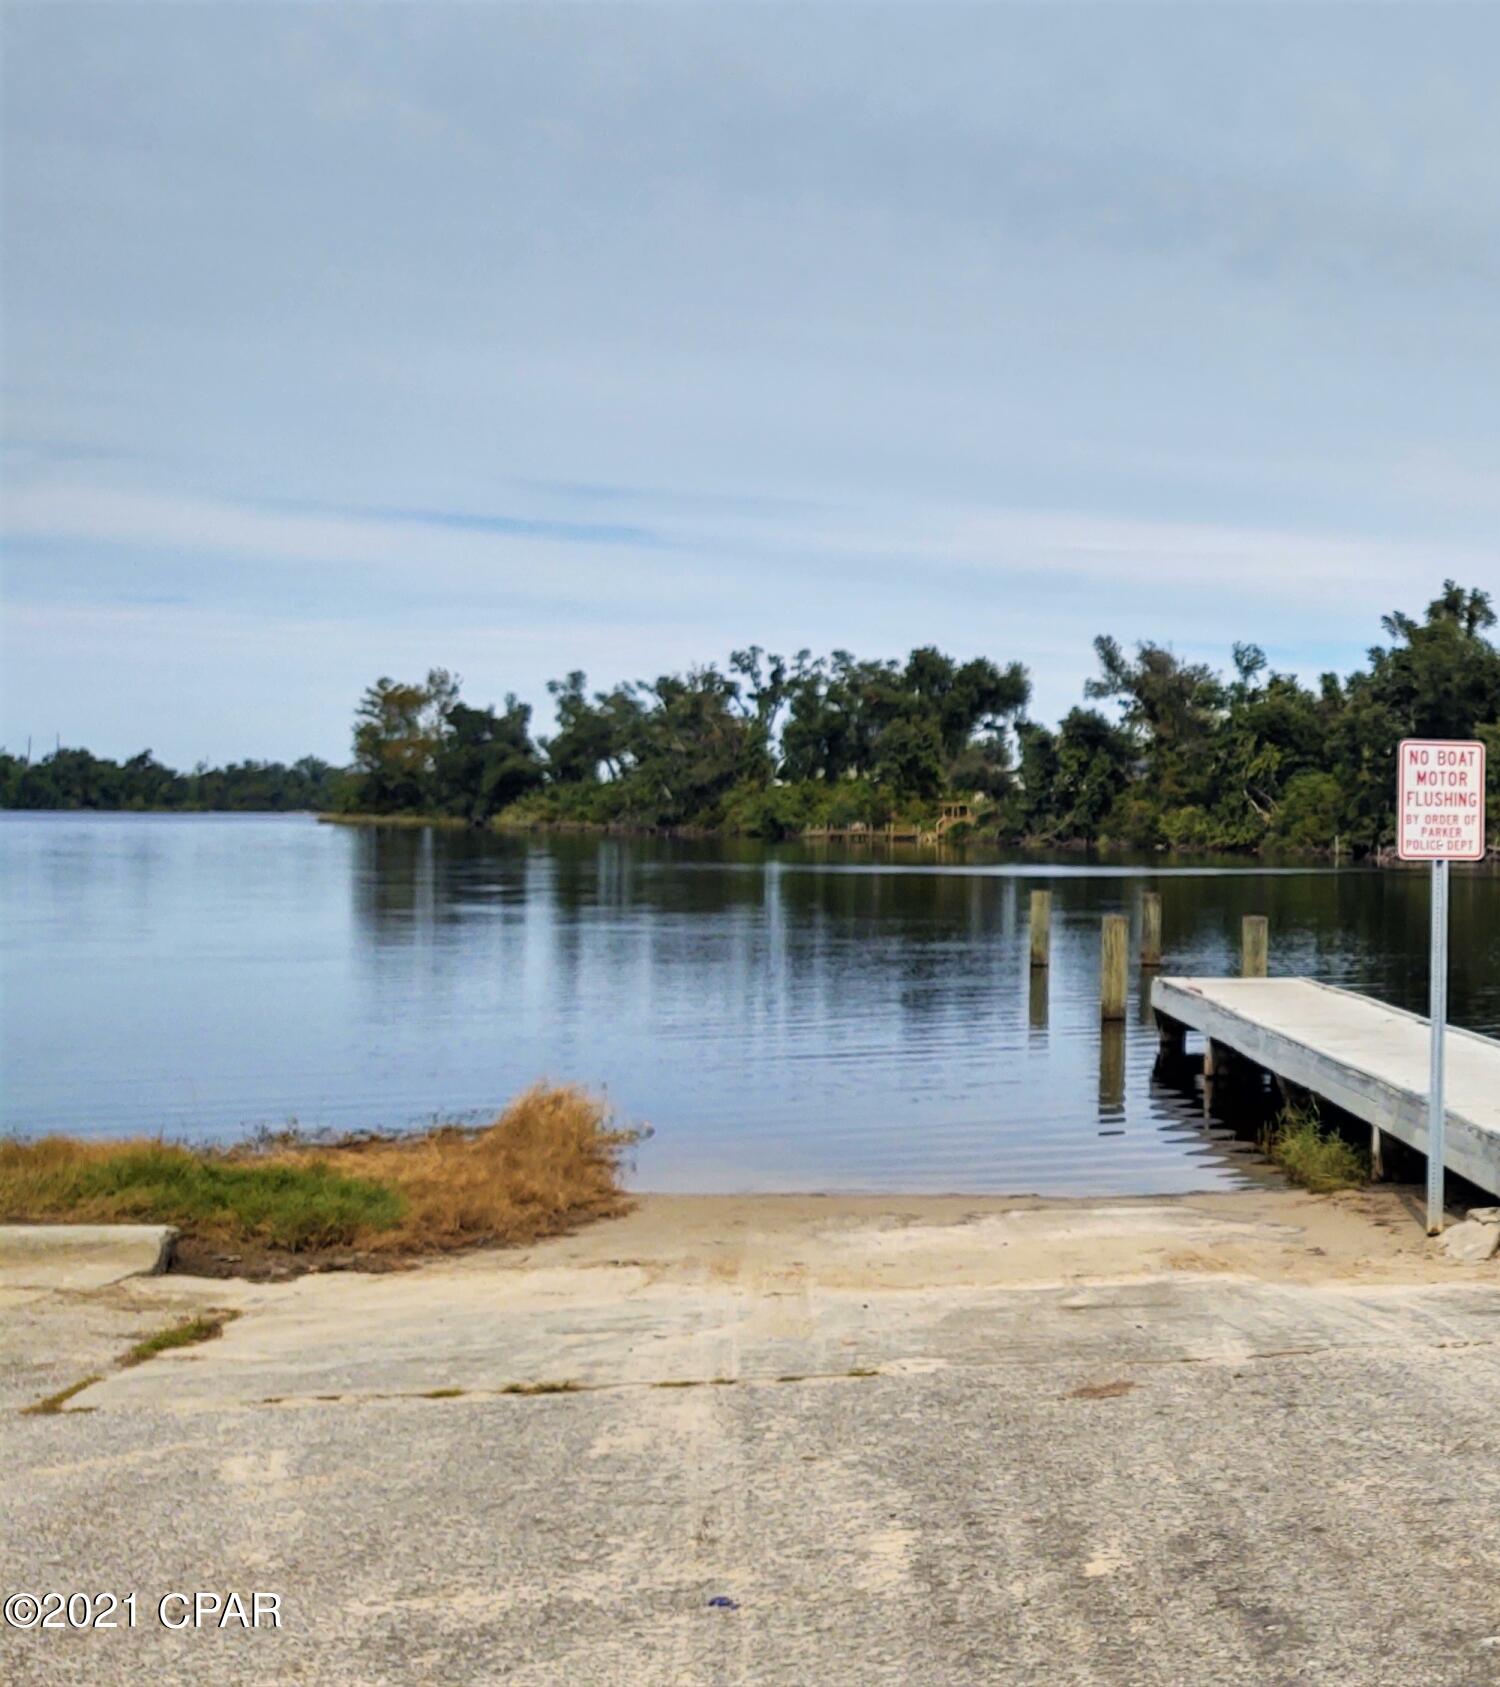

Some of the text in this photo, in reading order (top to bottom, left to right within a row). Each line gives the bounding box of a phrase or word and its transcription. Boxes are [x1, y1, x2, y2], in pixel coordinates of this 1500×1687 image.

[1409, 750, 1475, 766] NO BOAT
[1416, 771, 1468, 786] MOTOR
[1406, 791, 1477, 807] FLUSHING
[1406, 814, 1477, 825] BY ORDER OF
[1421, 827, 1462, 838] PARKER
[1406, 840, 1473, 851] POLICE DEPT
